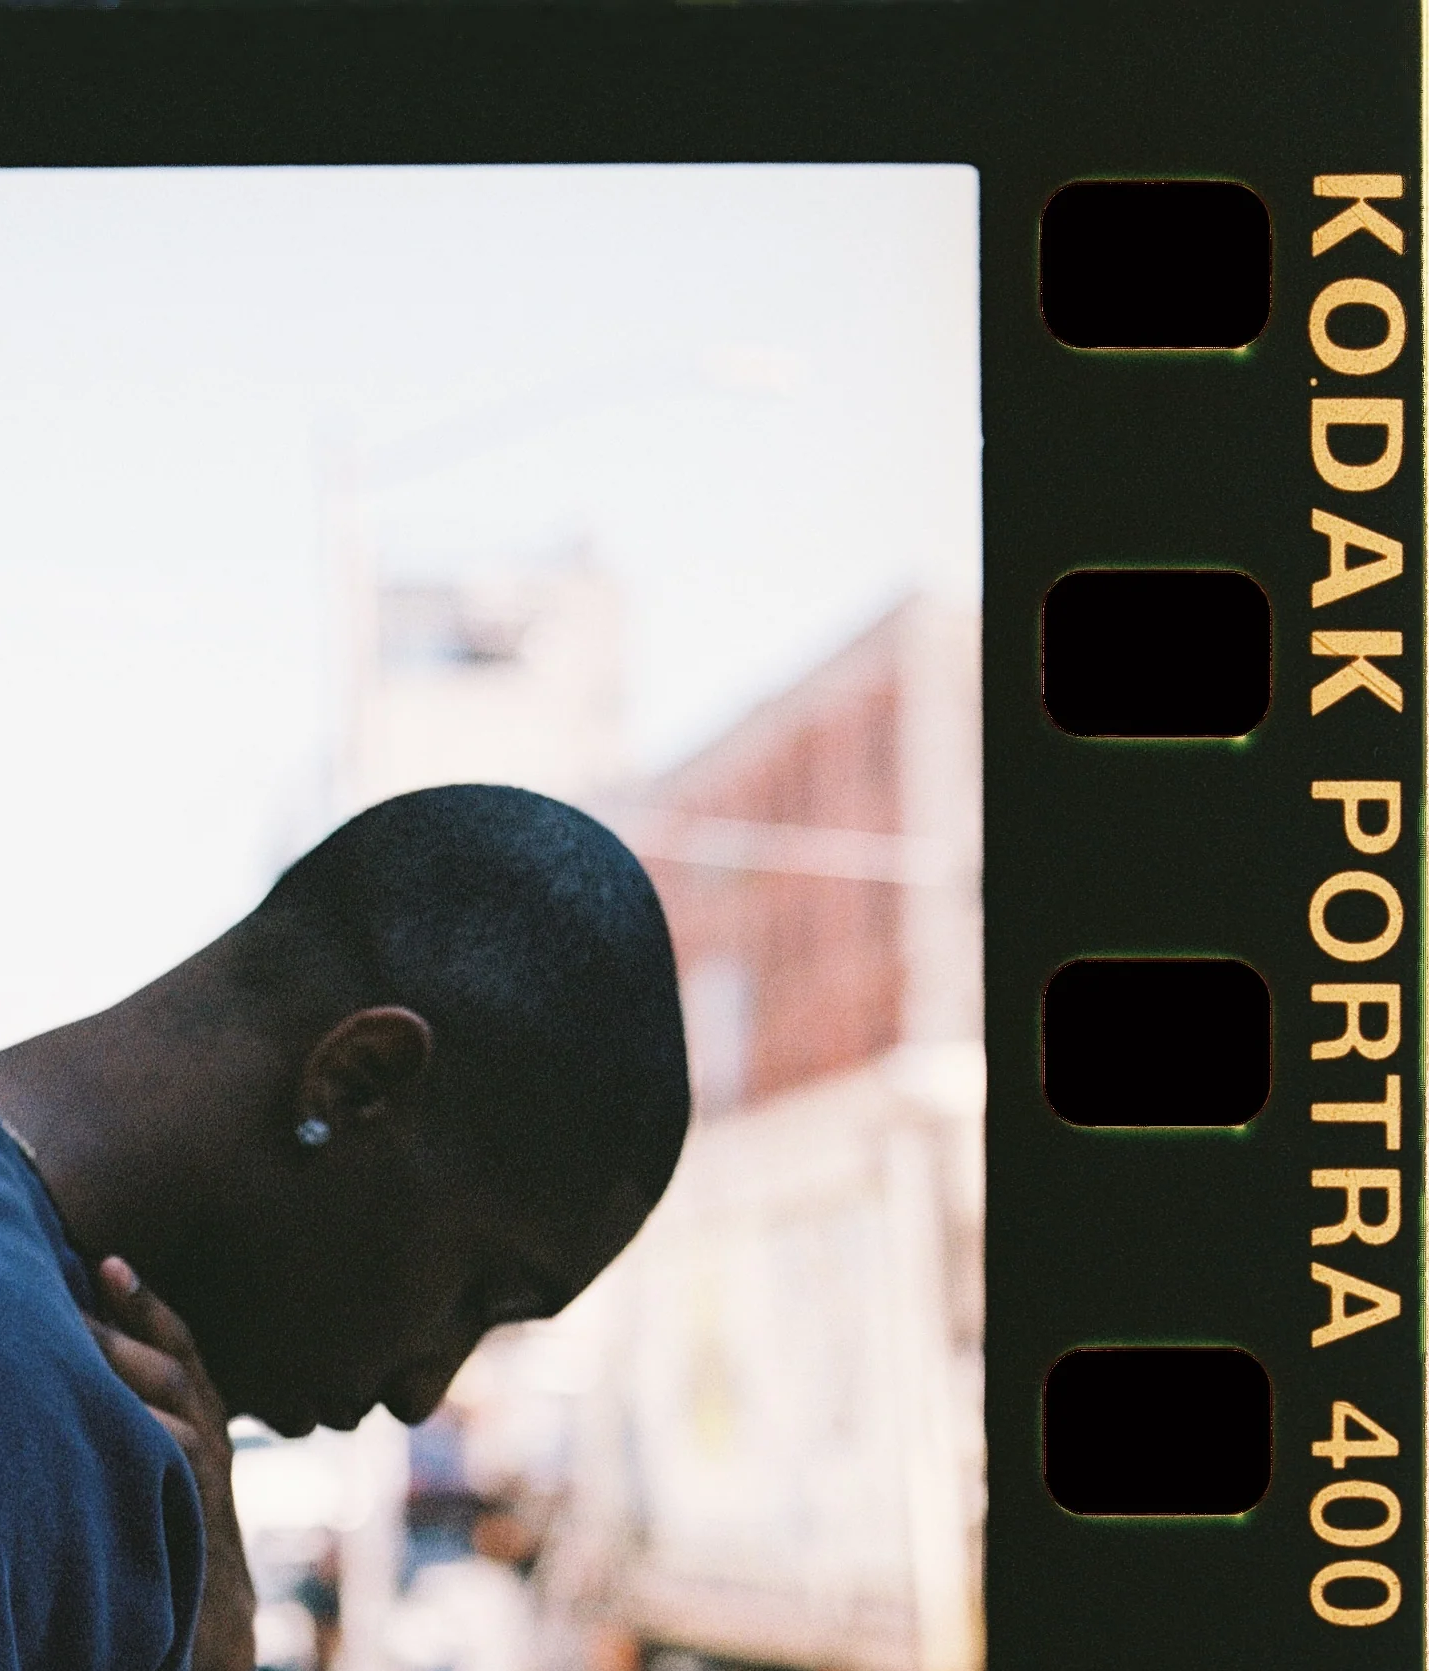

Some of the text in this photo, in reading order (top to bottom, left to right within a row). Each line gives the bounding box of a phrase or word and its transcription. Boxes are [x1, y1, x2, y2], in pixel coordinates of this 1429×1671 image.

[1307, 174, 1405, 1627] KODAK PORTRA 400
